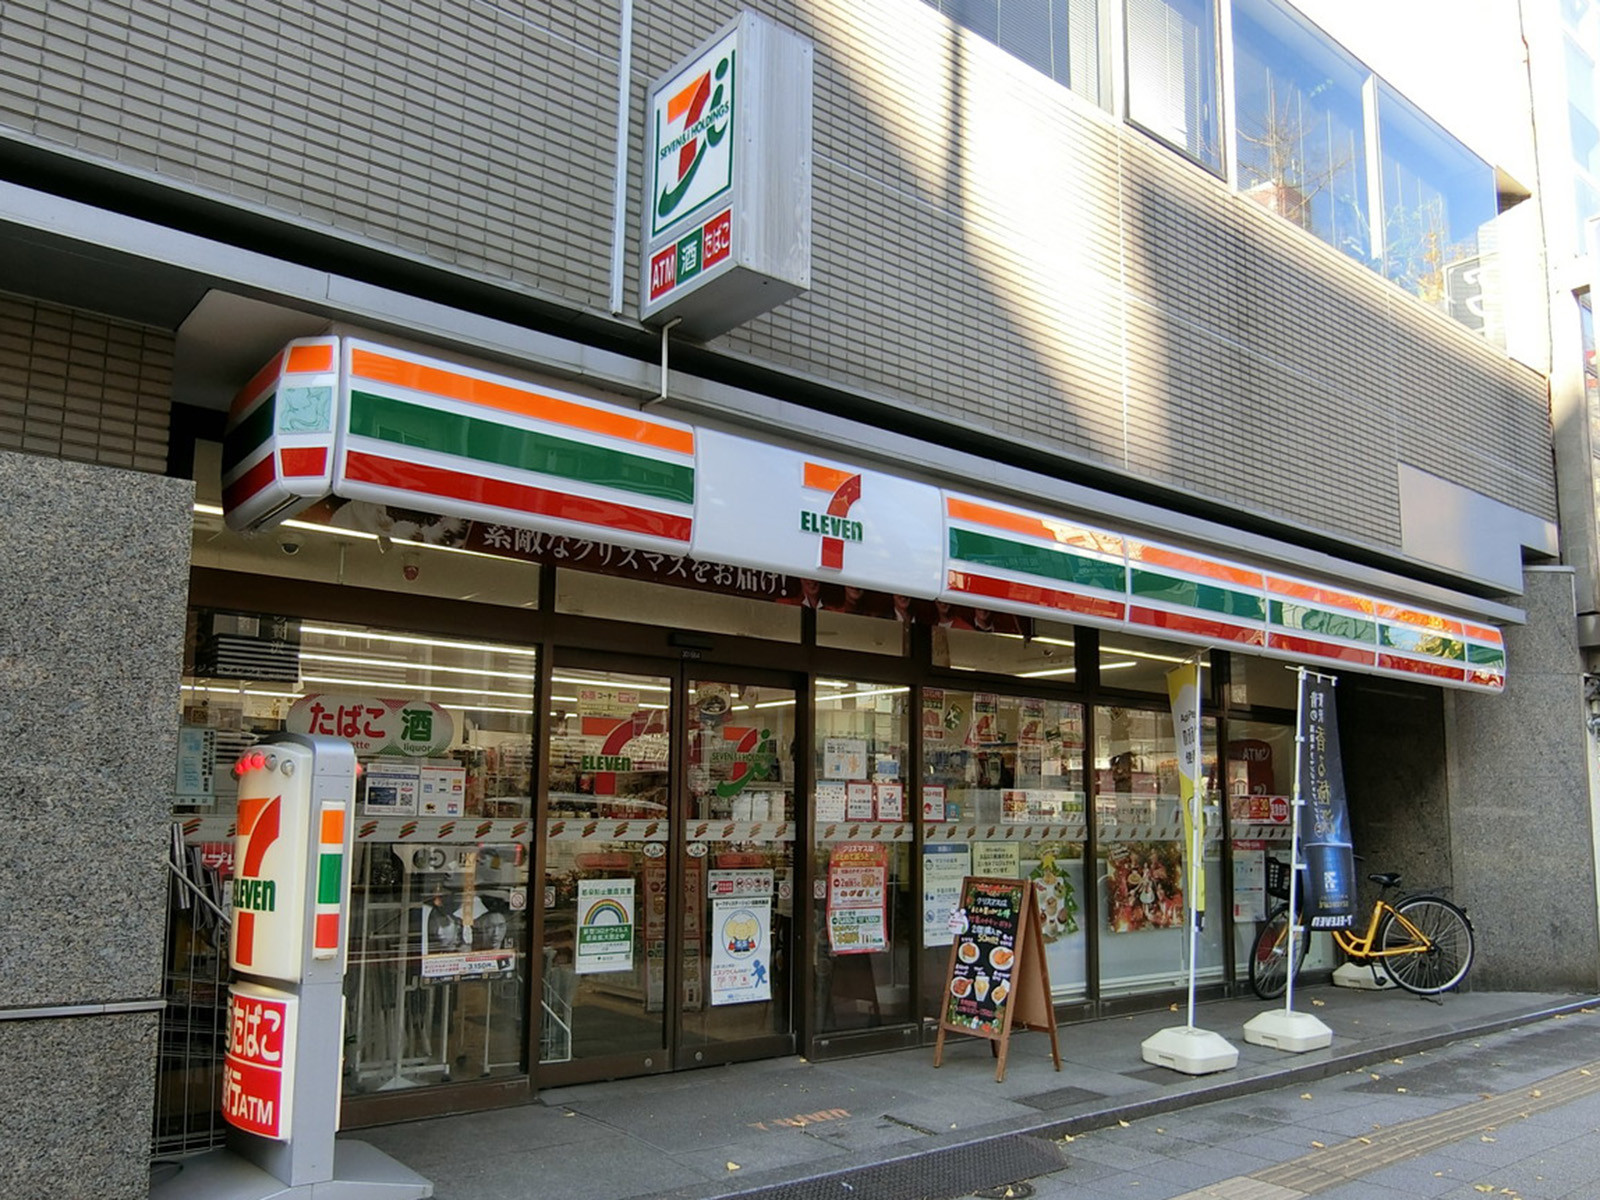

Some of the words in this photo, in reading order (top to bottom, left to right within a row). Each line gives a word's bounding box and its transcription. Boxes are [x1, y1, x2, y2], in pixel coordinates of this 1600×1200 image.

[651, 254, 676, 292] ATM
[681, 239, 699, 276] 酒
[704, 222, 731, 259] たばこ
[308, 703, 388, 739] たばこ
[401, 707, 433, 742] 酒
[231, 1006, 281, 1063] たばこ
